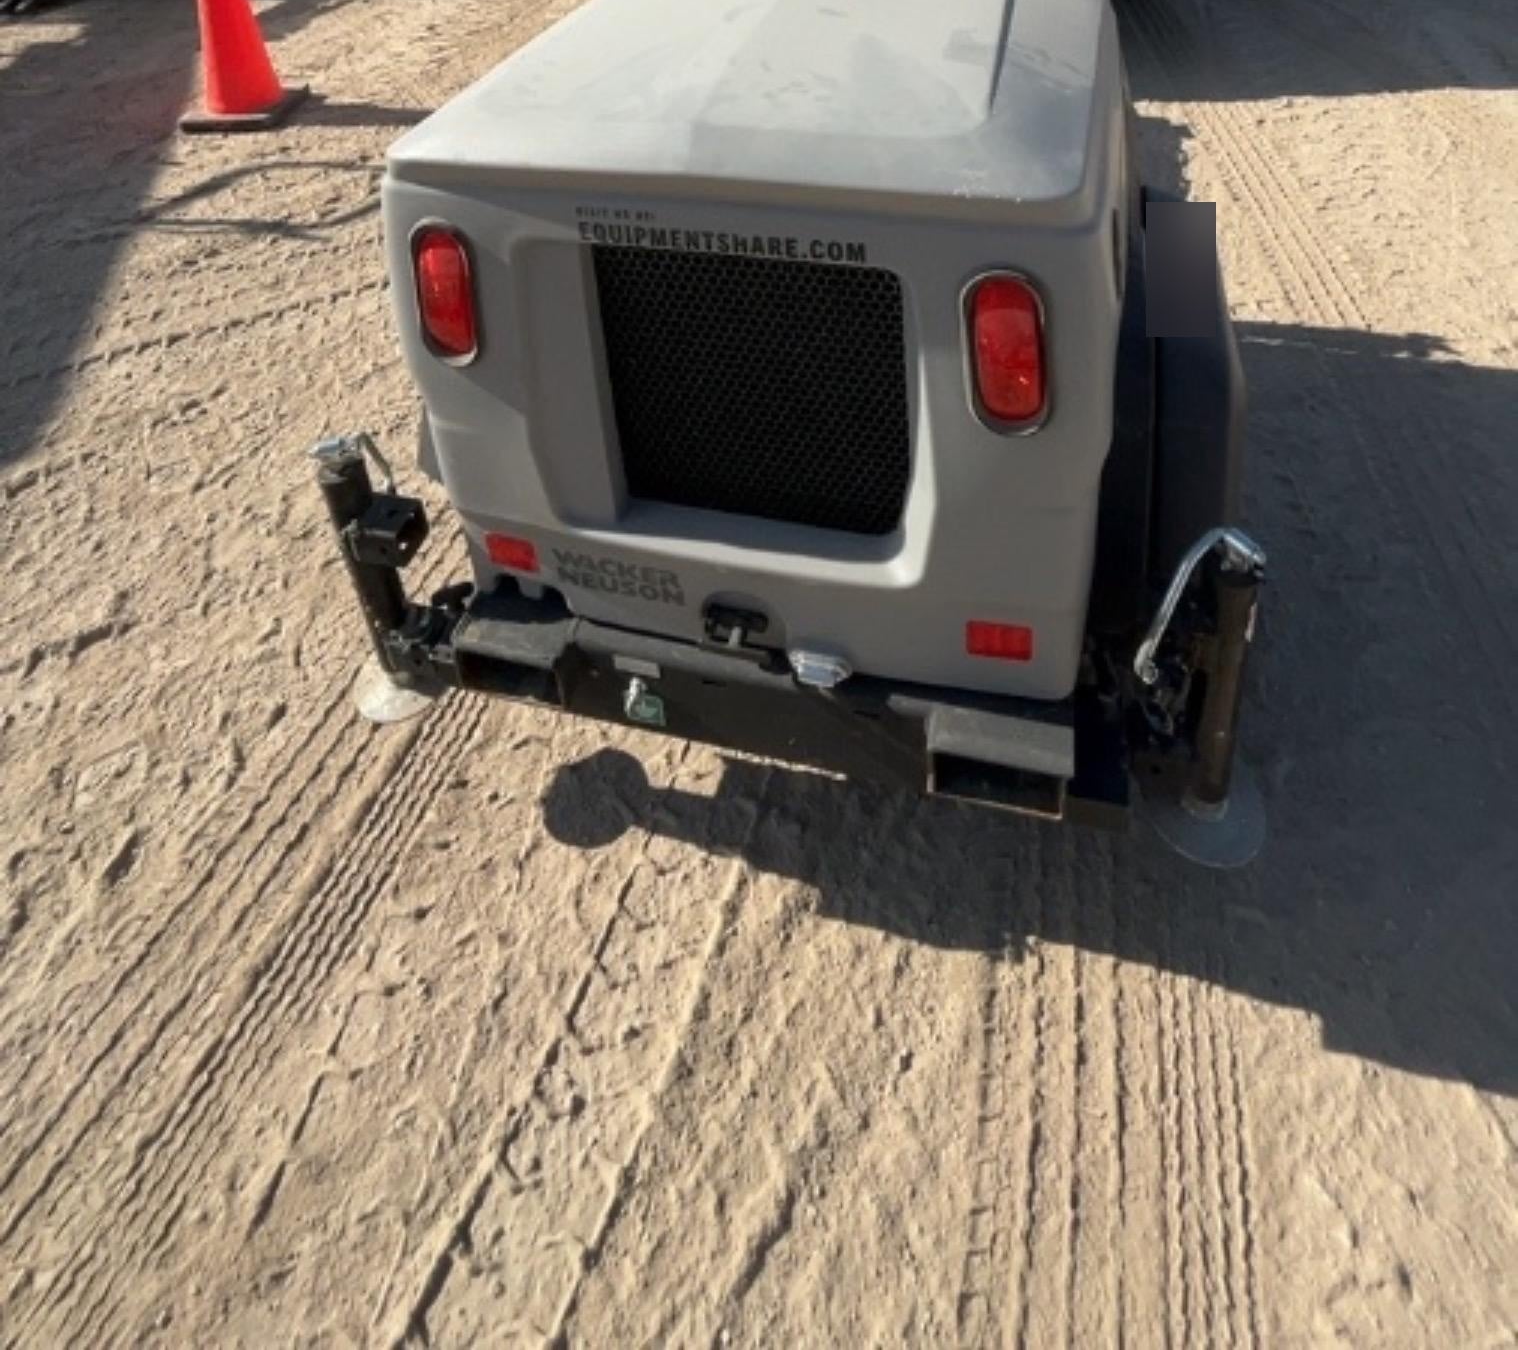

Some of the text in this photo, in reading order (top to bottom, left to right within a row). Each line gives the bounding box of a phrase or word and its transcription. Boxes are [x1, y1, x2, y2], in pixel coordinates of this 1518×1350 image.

[578, 221, 867, 263] EQUIPMENTSHARE.COM
[551, 548, 681, 588] WACKER
[557, 567, 686, 607] NEUSON
